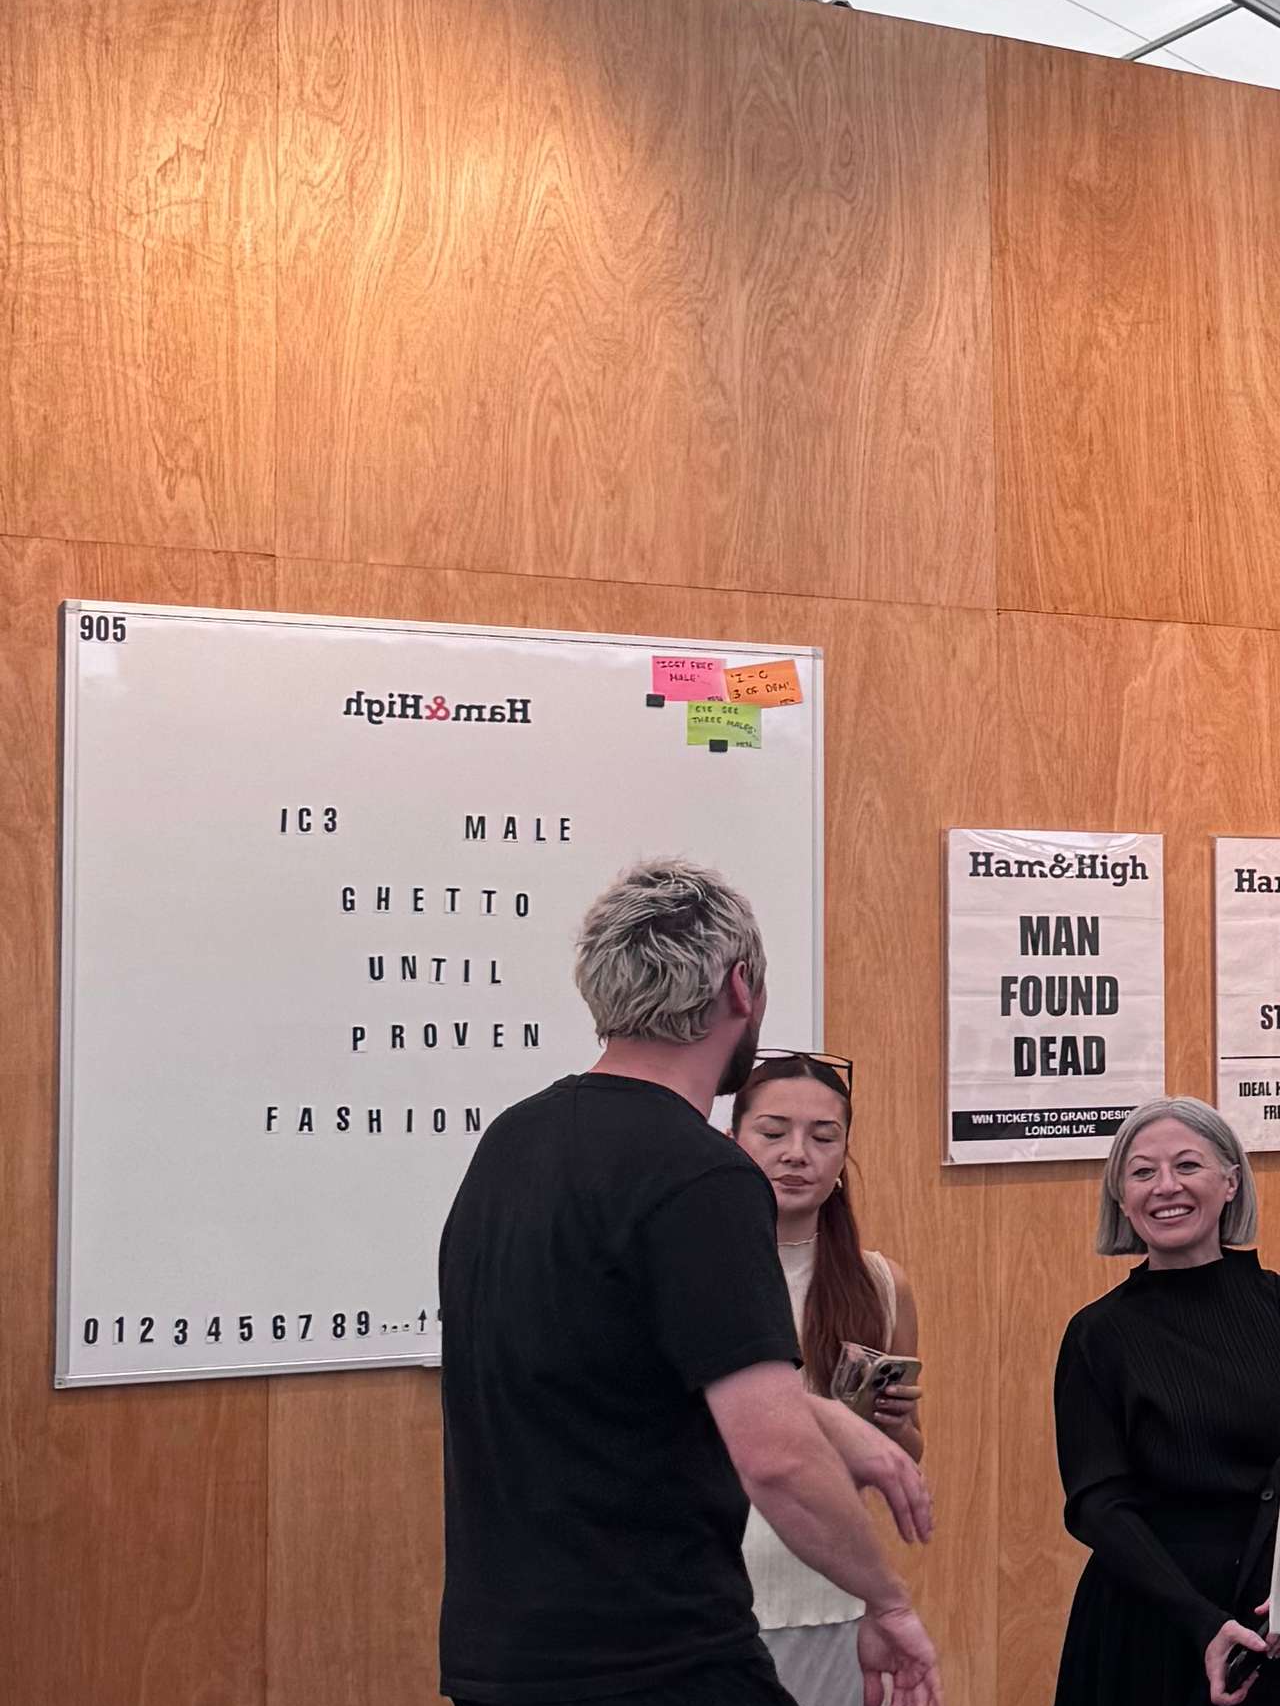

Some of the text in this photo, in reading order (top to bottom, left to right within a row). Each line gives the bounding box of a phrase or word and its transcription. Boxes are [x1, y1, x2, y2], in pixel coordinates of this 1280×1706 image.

[79, 614, 128, 642] 905
[280, 808, 571, 842] IC3 MALE
[969, 851, 1149, 887] Ham&High
[342, 886, 530, 918] GHETTO
[1019, 916, 1100, 956] MAN
[368, 955, 502, 984] UNTIL
[1001, 976, 1119, 1017] FOUND
[352, 1022, 540, 1052] PROVEN
[1013, 1036, 1106, 1078] DEAD
[1239, 1081, 1272, 1097] IDEAL
[972, 1114, 993, 1124] WIN
[996, 1114, 1041, 1124] TICKETS
[1044, 1112, 1058, 1122] TO
[1060, 1111, 1098, 1121] GRAND
[1025, 1124, 1096, 1136] LONDON LIVE
